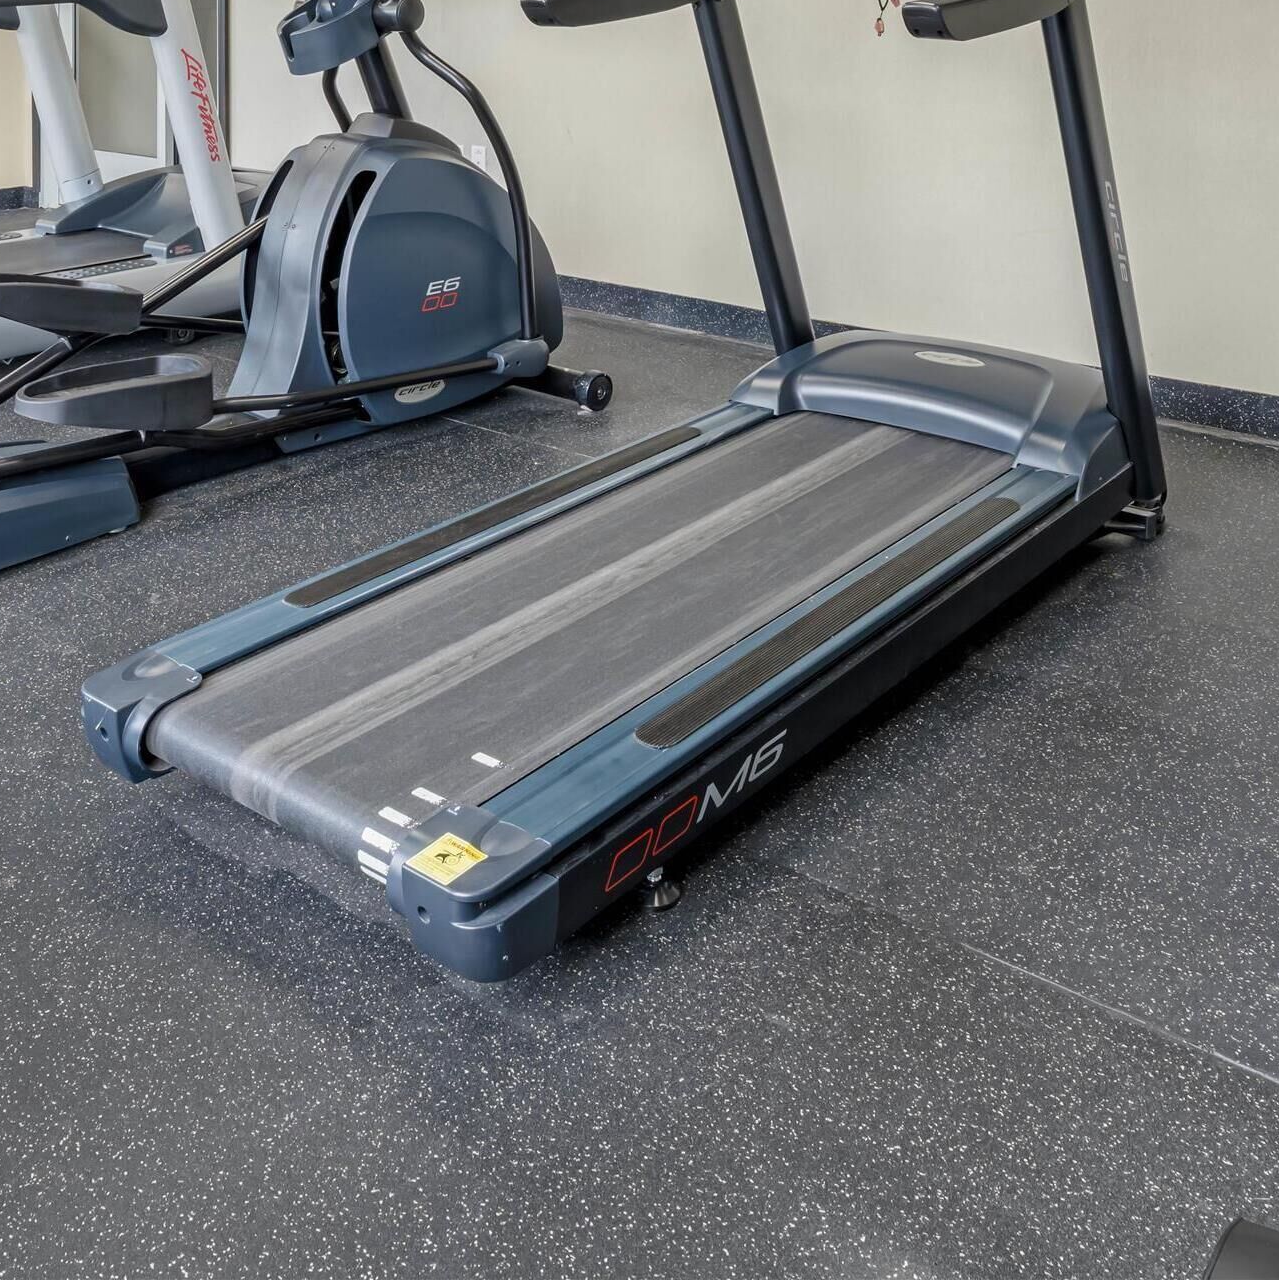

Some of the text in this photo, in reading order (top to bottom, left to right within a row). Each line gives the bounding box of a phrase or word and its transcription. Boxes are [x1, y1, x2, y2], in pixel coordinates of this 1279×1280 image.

[180, 48, 221, 162] Life Fitness
[425, 276, 461, 296] E6
[696, 728, 788, 825] M6
